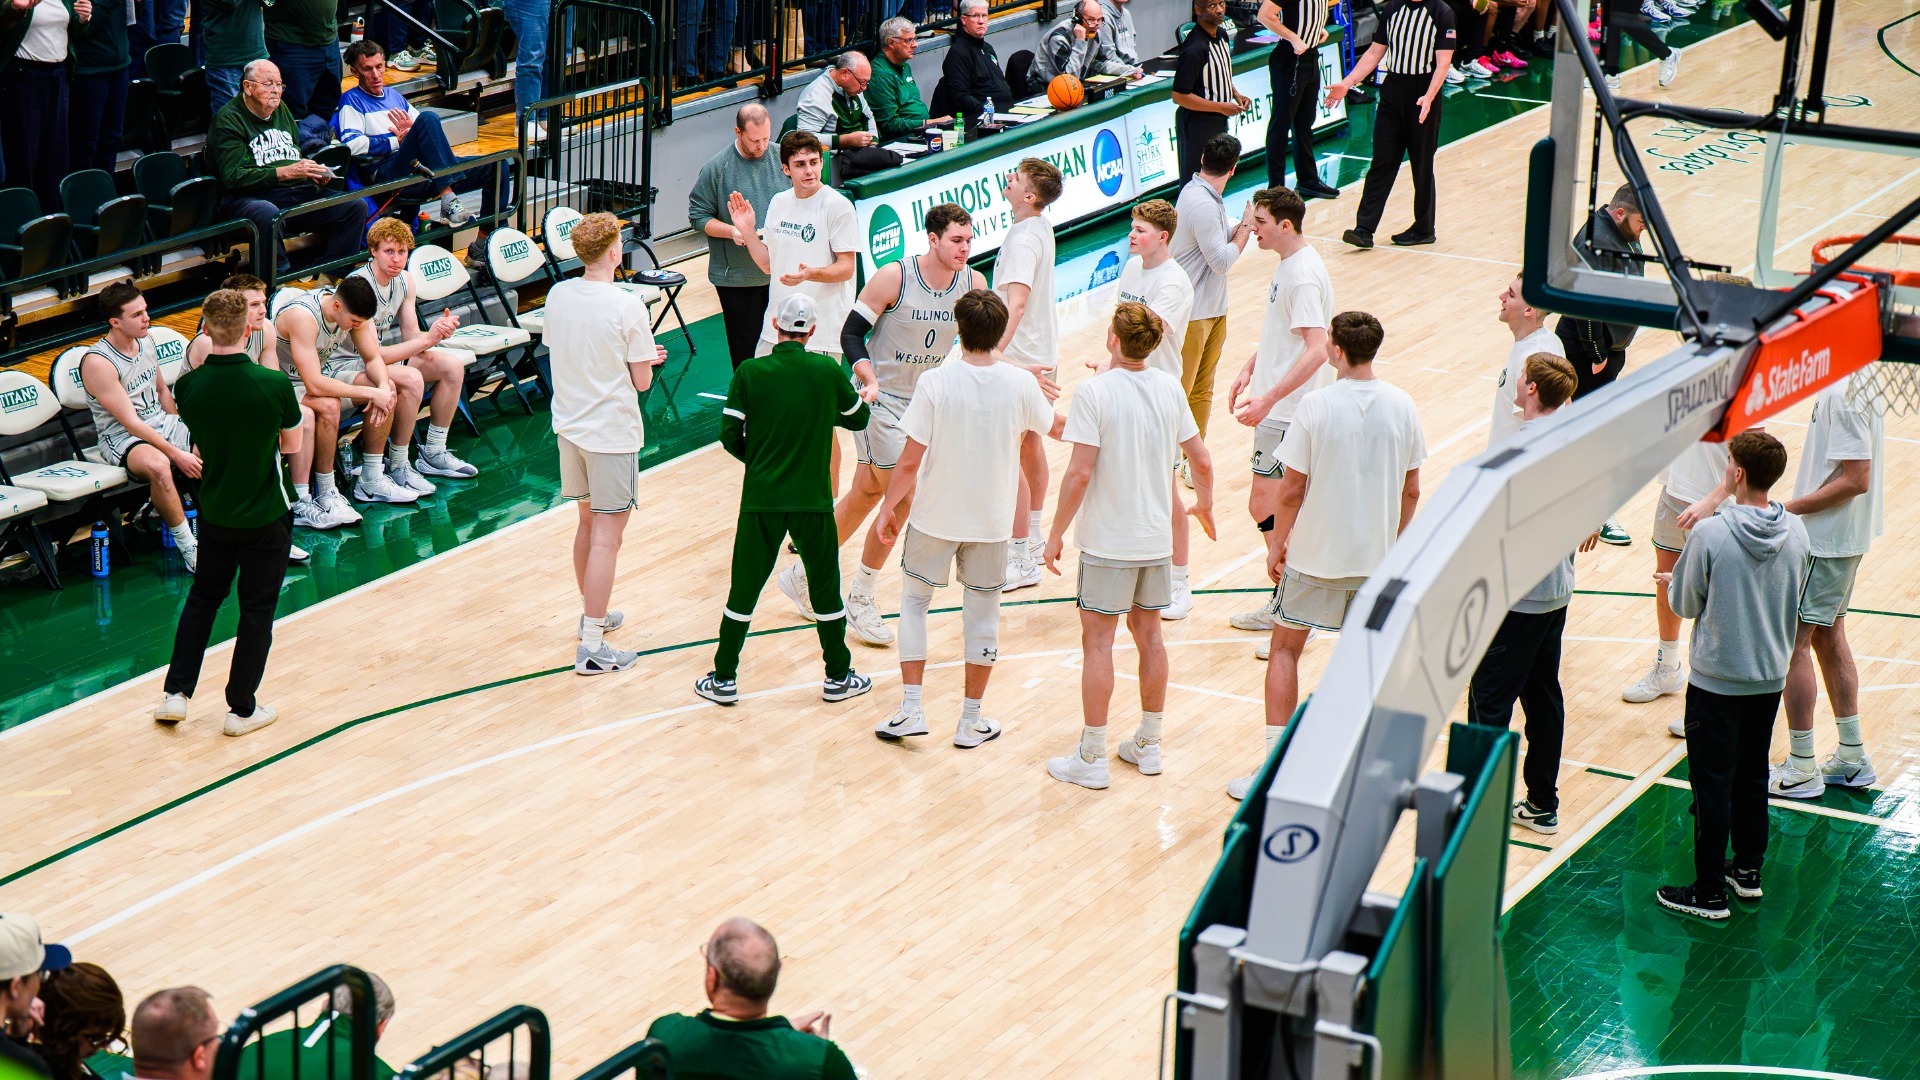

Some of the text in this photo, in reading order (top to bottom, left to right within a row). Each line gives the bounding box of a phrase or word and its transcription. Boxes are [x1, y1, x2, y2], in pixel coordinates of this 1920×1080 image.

[1136, 144, 1162, 164] SHIRK
[1096, 158, 1124, 183] NCAA
[501, 241, 529, 259] TITANS
[421, 259, 452, 277] TITANS
[924, 328, 936, 350] 0
[157, 341, 183, 359] TANS
[0, 385, 38, 408] TITANS
[1665, 356, 1734, 433] SPALDING
